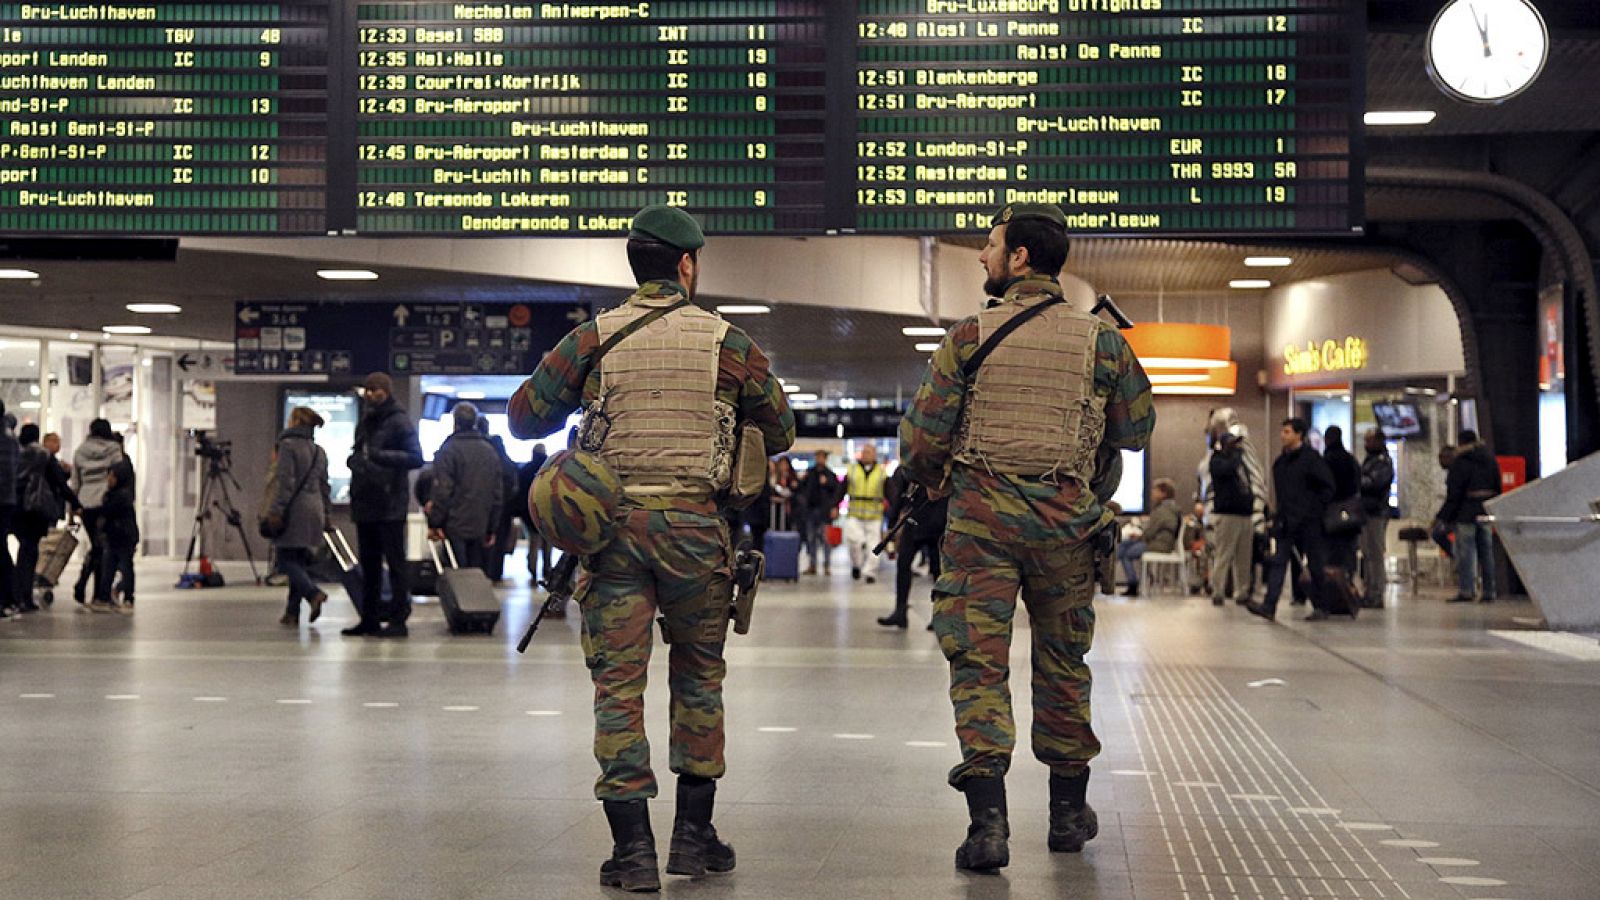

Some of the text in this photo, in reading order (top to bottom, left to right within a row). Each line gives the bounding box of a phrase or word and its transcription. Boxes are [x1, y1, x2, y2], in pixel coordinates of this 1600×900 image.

[21, 4, 156, 20] Bru-Luchthaven
[453, 2, 649, 20] Mechelen Antwerpen-C
[360, 27, 407, 44] 12:33
[415, 27, 463, 43] Basel
[657, 25, 689, 42] INT
[747, 24, 765, 40] 11
[916, 21, 965, 38] Alost
[976, 21, 999, 37] La
[1007, 20, 1059, 37] Panne
[1182, 17, 1204, 34] IC
[1267, 15, 1287, 32] 12
[164, 28, 195, 44] TGV
[49, 51, 108, 67] Landen
[174, 51, 194, 67] IC
[260, 51, 271, 67] 9
[359, 51, 407, 67] 12:35
[667, 49, 689, 65] IC
[747, 48, 767, 64] 19
[1016, 44, 1067, 60] Aalst
[1109, 43, 1162, 59] Panne
[96, 74, 156, 90] Landen
[359, 74, 407, 90] 12:39
[667, 72, 688, 89] IC
[858, 69, 905, 86] 12:51
[916, 69, 1038, 87] Blankenberge
[1181, 66, 1203, 82] IC
[173, 97, 193, 114] IC
[251, 98, 270, 114] 13
[359, 97, 406, 114] 12:43
[667, 96, 688, 112] IC
[858, 93, 904, 110] 12:51
[1180, 90, 1203, 107] IC
[1266, 88, 1286, 105] 17
[10, 121, 155, 137] Aalst Gent-St-P
[511, 121, 649, 137] Bru-Luchthaven
[1016, 115, 1161, 133] Bru-Luchthaven
[173, 144, 193, 160] IC
[251, 144, 270, 161] 12
[358, 144, 406, 161] 12:45
[540, 144, 629, 160] Amsterdam
[637, 143, 648, 160] C
[666, 143, 687, 160] IC
[747, 143, 766, 159] 13
[857, 138, 1284, 157] 12:52 London-St-P EUR 1
[172, 167, 193, 184] IC
[251, 168, 270, 184] 10
[433, 167, 648, 184] Bru-Luchth Amsterdam C
[857, 165, 906, 182] 12:52
[915, 165, 1007, 181] Amsterdam
[1016, 164, 1028, 181] C
[1171, 163, 1202, 179] THA
[1211, 162, 1254, 179] 9993
[19, 190, 154, 207] Bru-Luchthaven
[414, 191, 493, 207] Termonde
[500, 191, 570, 207] Lokeren
[666, 191, 687, 207] IC
[754, 190, 766, 207] 9
[857, 188, 907, 205] 12:53
[1005, 188, 1120, 205] Denderleeuw
[1190, 187, 1202, 204] L
[1266, 186, 1285, 203] 19
